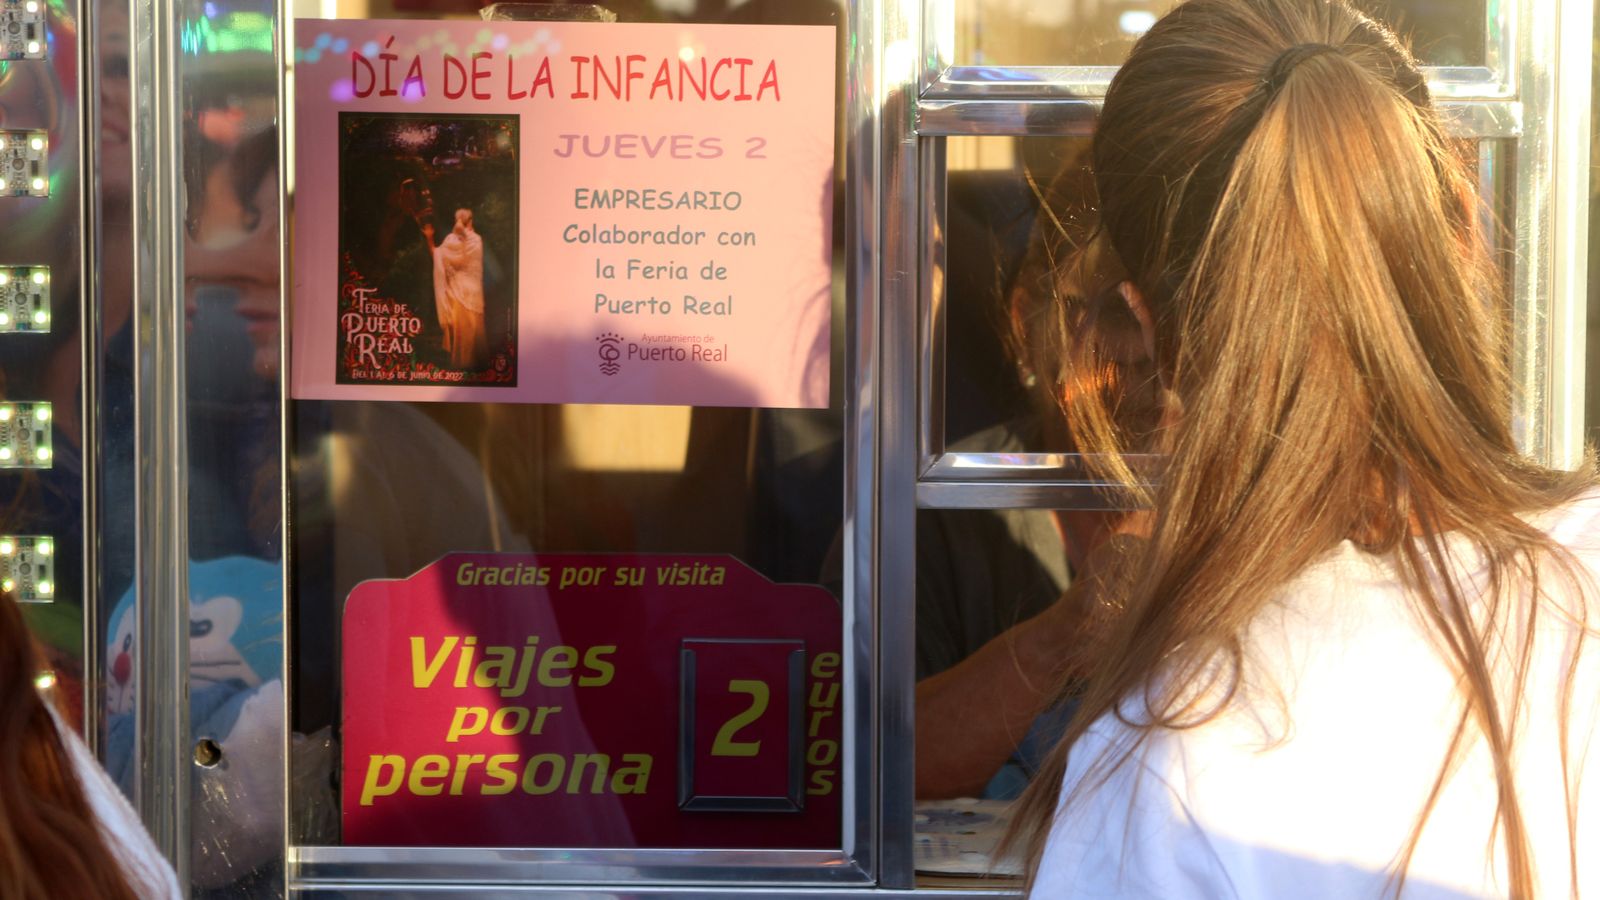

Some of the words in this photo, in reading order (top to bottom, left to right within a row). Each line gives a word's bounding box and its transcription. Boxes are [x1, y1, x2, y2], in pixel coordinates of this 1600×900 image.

[352, 35, 426, 99] DÍA
[443, 52, 493, 100] DE
[507, 53, 554, 100] LA
[570, 54, 780, 102] INFANCIA
[553, 134, 724, 159] JUEVES
[745, 136, 767, 159] 2
[574, 188, 742, 211] EMPRESARIO
[563, 223, 706, 245] Colaborador
[717, 231, 756, 246] con
[596, 258, 615, 279] la
[627, 259, 689, 280] Feria
[700, 260, 728, 280] de
[352, 287, 390, 315] FERIA
[394, 303, 408, 314] DE
[594, 293, 672, 315] Puerto
[683, 294, 733, 315] Real
[341, 313, 422, 344] PUERTO
[641, 334, 702, 344] Ayuntamiento
[703, 334, 716, 343] de
[353, 333, 414, 369] REAL
[627, 343, 686, 362] Puerto
[691, 343, 728, 362] Real
[397, 371, 407, 380] DE
[410, 371, 430, 381] JUNIO
[456, 563, 551, 586] Gracias
[559, 566, 606, 590] por
[614, 566, 646, 586] su
[656, 564, 726, 586] visita
[410, 636, 617, 697] Viajes
[446, 706, 562, 743] por
[711, 679, 770, 757] 2
[807, 652, 841, 796] euros
[360, 753, 653, 806] persona
